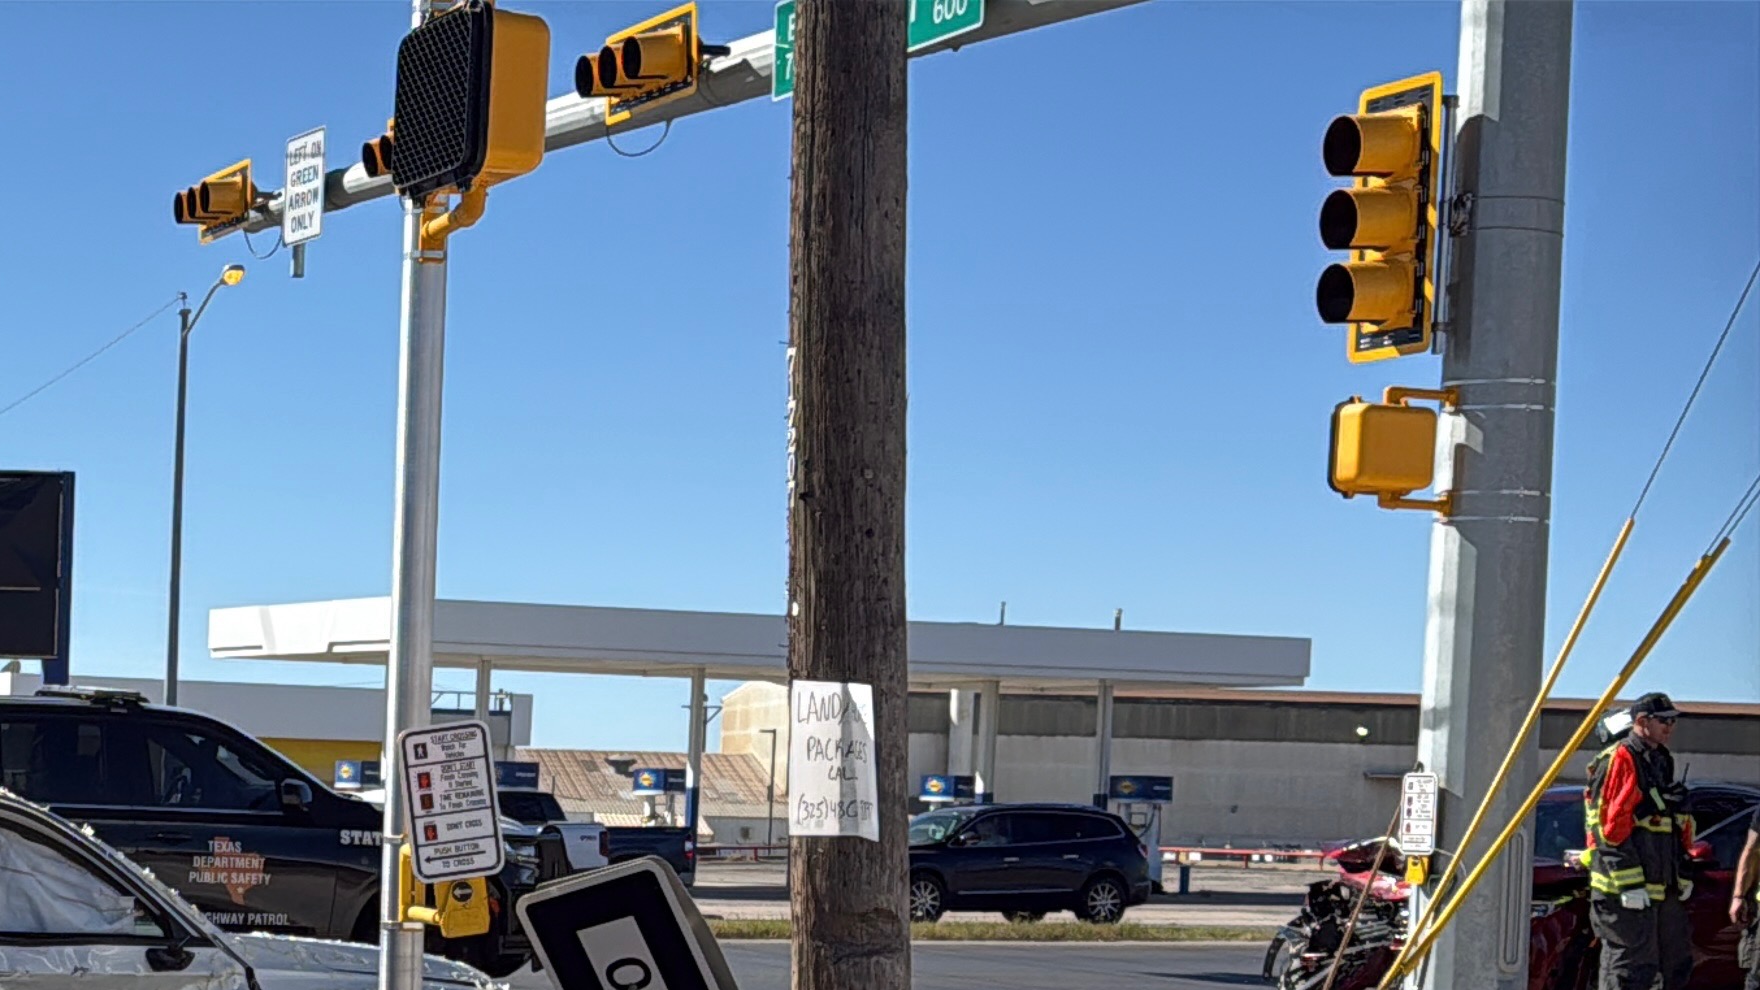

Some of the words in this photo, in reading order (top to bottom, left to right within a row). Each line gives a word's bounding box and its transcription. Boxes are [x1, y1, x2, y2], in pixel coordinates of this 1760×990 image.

[933, 0, 967, 24] 600
[290, 165, 319, 188] GREEN
[288, 187, 319, 212] ARROW
[291, 211, 315, 233] ONLY
[340, 830, 382, 846] STAT
[208, 840, 242, 853] TEXAS
[193, 856, 265, 869] DEPARTMENT
[189, 871, 228, 884] PUBLIC
[231, 873, 271, 885] SAFETY
[205, 912, 245, 926] GHWAY
[247, 914, 289, 926] PATROL
